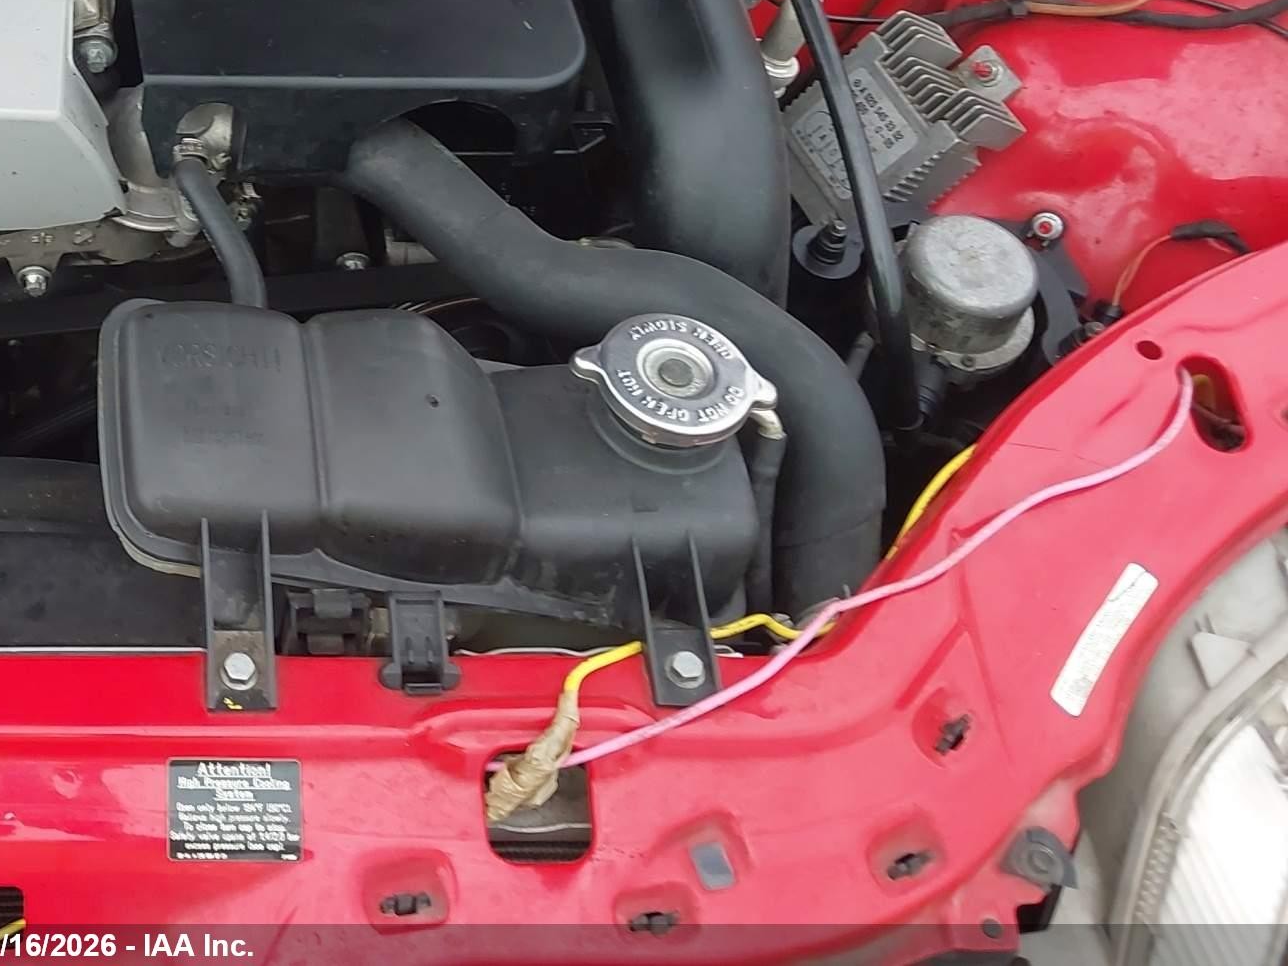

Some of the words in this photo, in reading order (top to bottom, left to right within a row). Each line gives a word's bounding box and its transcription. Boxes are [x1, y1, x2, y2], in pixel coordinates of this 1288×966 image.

[630, 318, 688, 341] SLOWLY
[616, 368, 644, 397] HOT
[722, 385, 745, 406] DO
[641, 395, 691, 423] OPEN
[697, 403, 730, 424] NOT
[196, 762, 272, 777] Attention!
[203, 777, 250, 789] Pressure
[252, 778, 291, 790] Cooling
